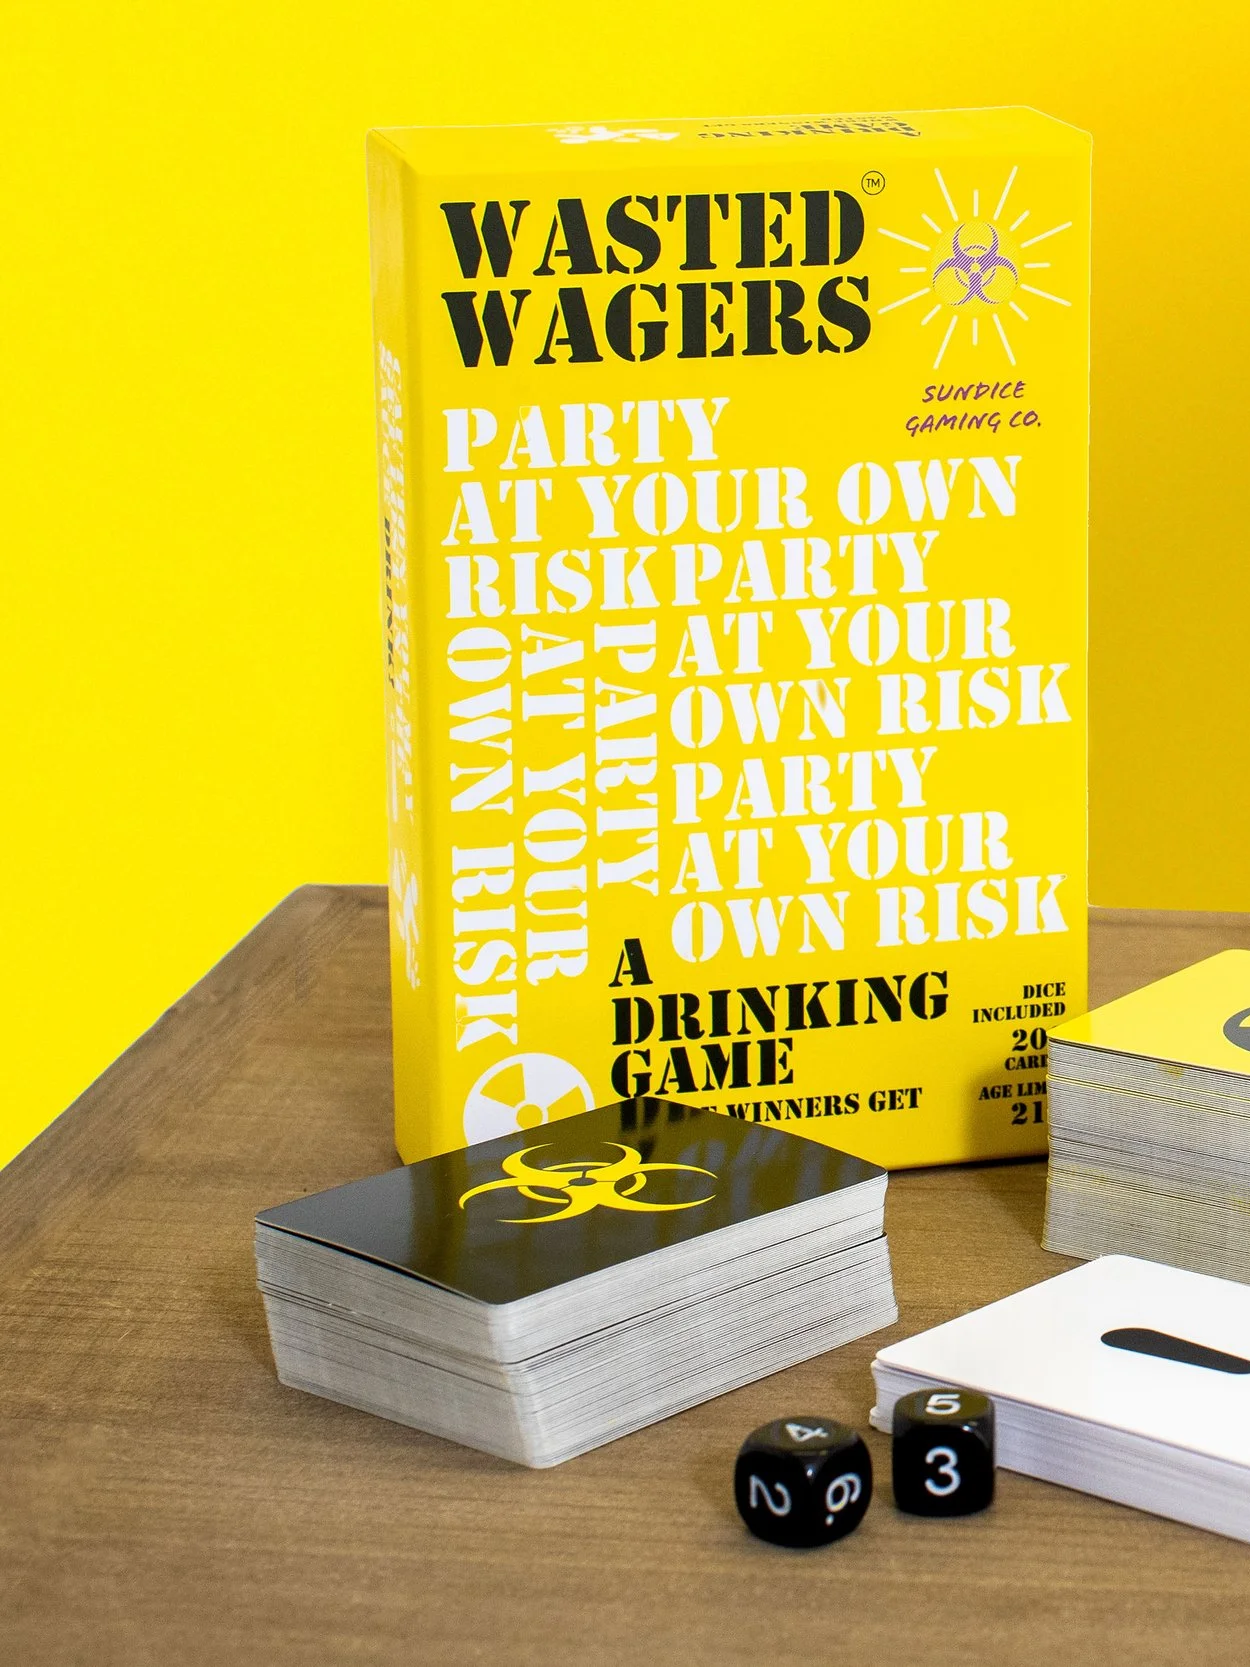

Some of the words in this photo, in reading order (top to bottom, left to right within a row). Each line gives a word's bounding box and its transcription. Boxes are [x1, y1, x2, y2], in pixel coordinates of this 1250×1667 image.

[440, 191, 864, 278] WASTED
[441, 276, 870, 367] WAGERS
[906, 412, 1001, 437] GAMING
[1009, 411, 1041, 427] CO.
[922, 381, 1026, 403] SUNDICE
[443, 398, 729, 472] PARTY
[442, 479, 552, 545] AT
[577, 467, 812, 538] YOUR
[838, 456, 1021, 525] OWN
[446, 546, 660, 618] RISK
[672, 531, 939, 606] PARTY
[669, 612, 772, 677] AT
[797, 598, 1015, 669] YOUR
[522, 624, 584, 729] AT
[671, 678, 850, 748] OWN
[878, 664, 1071, 734] RISK
[448, 628, 513, 814] OWN
[594, 620, 658, 895] PARTY
[672, 747, 937, 824] PARTY
[524, 756, 588, 985] YOUR
[670, 828, 772, 894] AT
[796, 812, 1012, 884] YOUR
[452, 843, 517, 1050] RISK
[672, 892, 849, 962] OWN
[877, 874, 1068, 946] RISK
[609, 939, 653, 987] A
[1024, 982, 1065, 999] DICE
[612, 971, 948, 1046] DRINKING
[974, 1002, 1065, 1023] INCLUDED
[1012, 1028, 1048, 1051] 20
[611, 1038, 793, 1098] GAME
[727, 1094, 860, 1123] WINNERS
[869, 1088, 922, 1112] GET
[979, 1085, 1012, 1100] AGE
[1017, 1081, 1047, 1096] LIM
[785, 1423, 829, 1442] 4
[925, 1393, 961, 1415] 5
[750, 1475, 792, 1516] 2
[925, 1446, 961, 1496] 3
